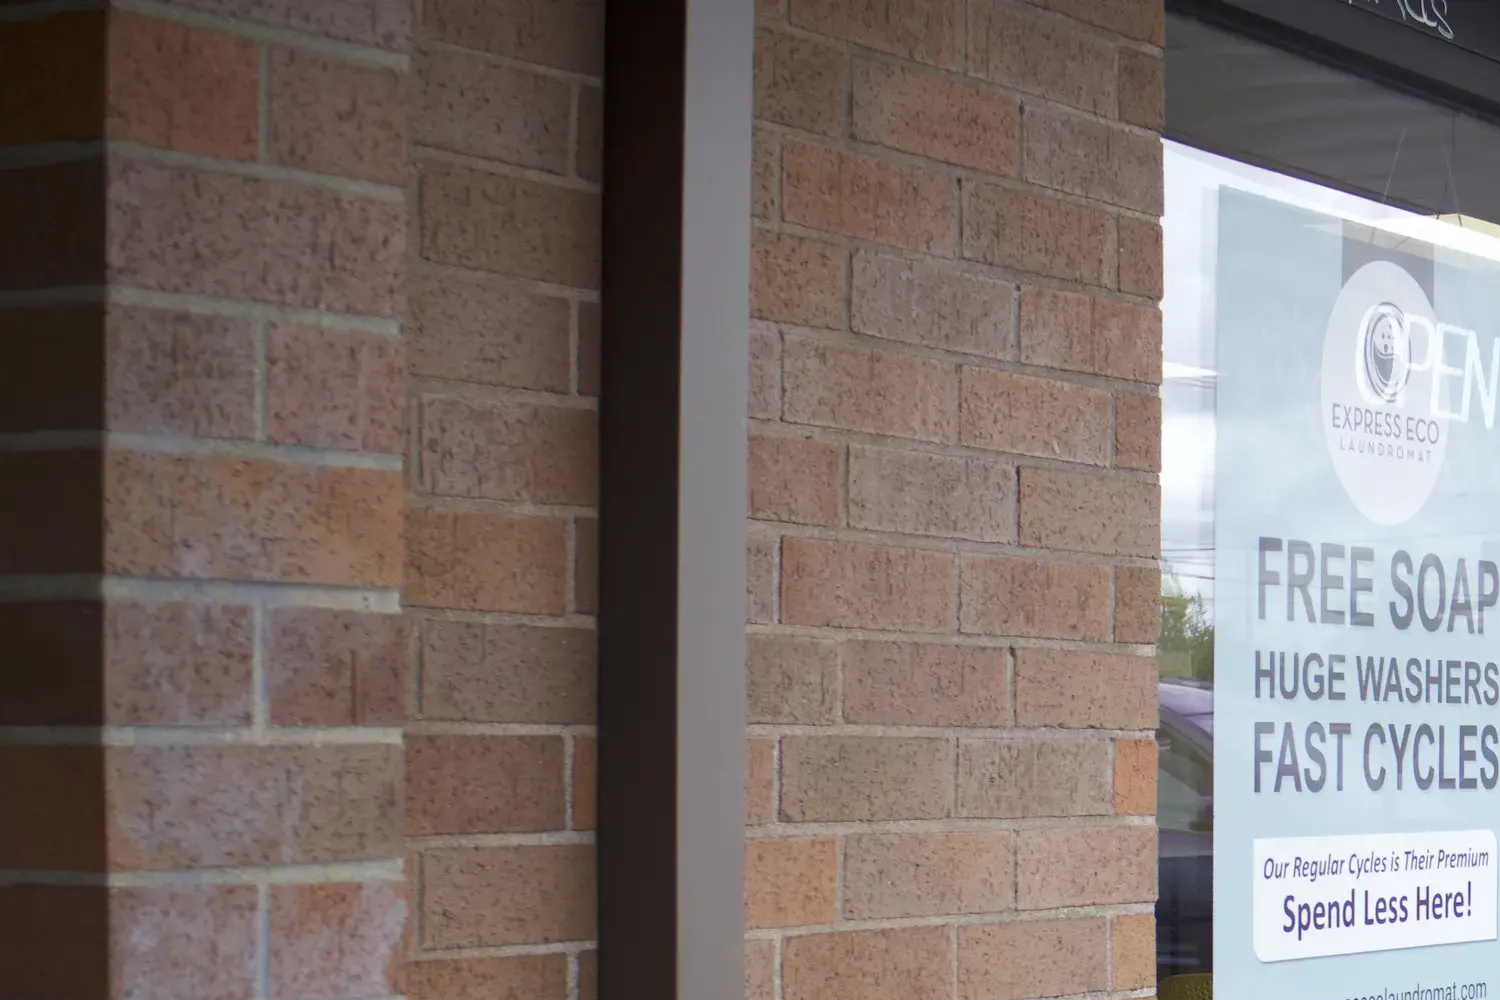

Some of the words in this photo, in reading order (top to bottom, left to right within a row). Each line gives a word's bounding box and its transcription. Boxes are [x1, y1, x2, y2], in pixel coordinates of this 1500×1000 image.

[1356, 303, 1500, 430] OPEN
[1332, 402, 1401, 439] EXPRESS
[1406, 416, 1439, 444] ECO
[1340, 436, 1432, 463] LAUNDROMAT
[1258, 536, 1374, 627] FREE
[1389, 549, 1500, 635] SOAP
[1255, 650, 1346, 701] HUGE
[1356, 655, 1499, 706] WASHERS
[1254, 721, 1351, 793] FAST
[1363, 722, 1499, 791] CYCLES
[1263, 857, 1290, 880] Our
[1293, 853, 1345, 883] Regular
[1349, 852, 1387, 880] Cycles
[1390, 851, 1400, 872] is
[1404, 848, 1435, 871] Their
[1437, 847, 1489, 869] Premium
[1283, 888, 1355, 941] Spend
[1364, 889, 1408, 926] Less
[1416, 881, 1472, 921] Here!
